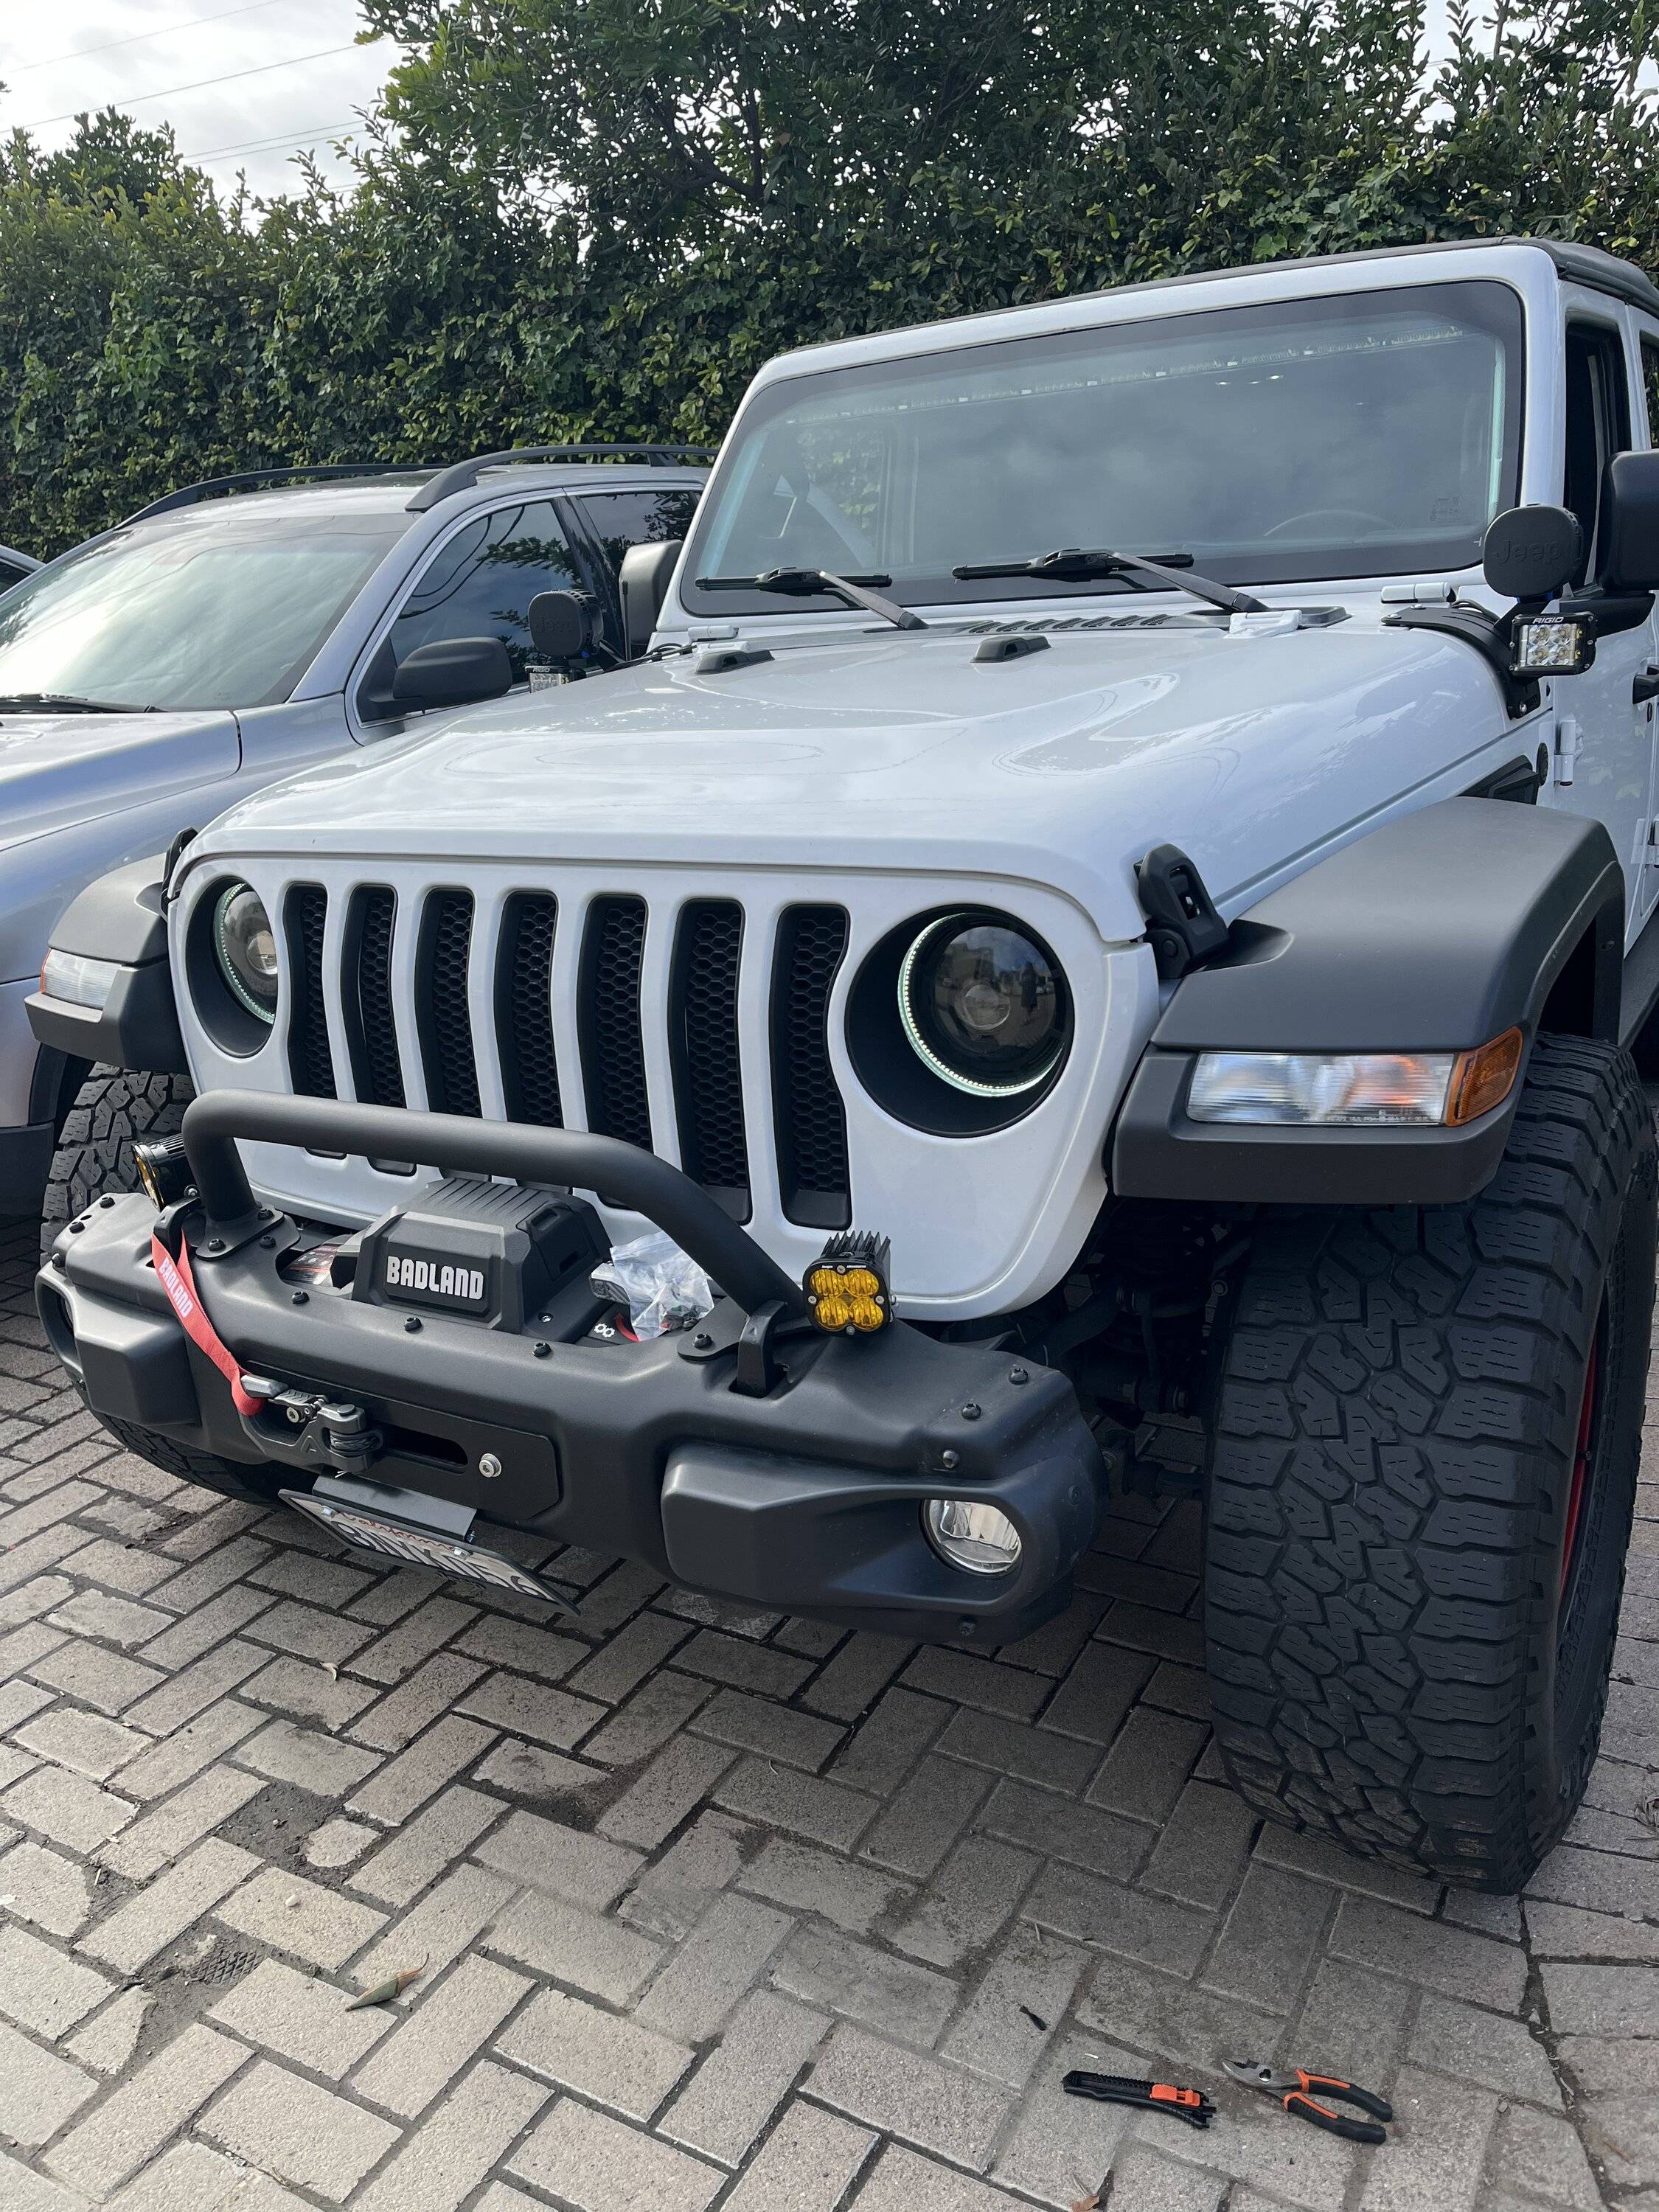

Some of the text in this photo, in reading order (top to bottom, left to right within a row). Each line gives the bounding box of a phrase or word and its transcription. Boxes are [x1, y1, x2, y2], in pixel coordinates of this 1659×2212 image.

[1492, 539, 1562, 565] Jeep
[159, 1256, 193, 1318] BADLAND
[386, 1256, 484, 1300] BADLAND
